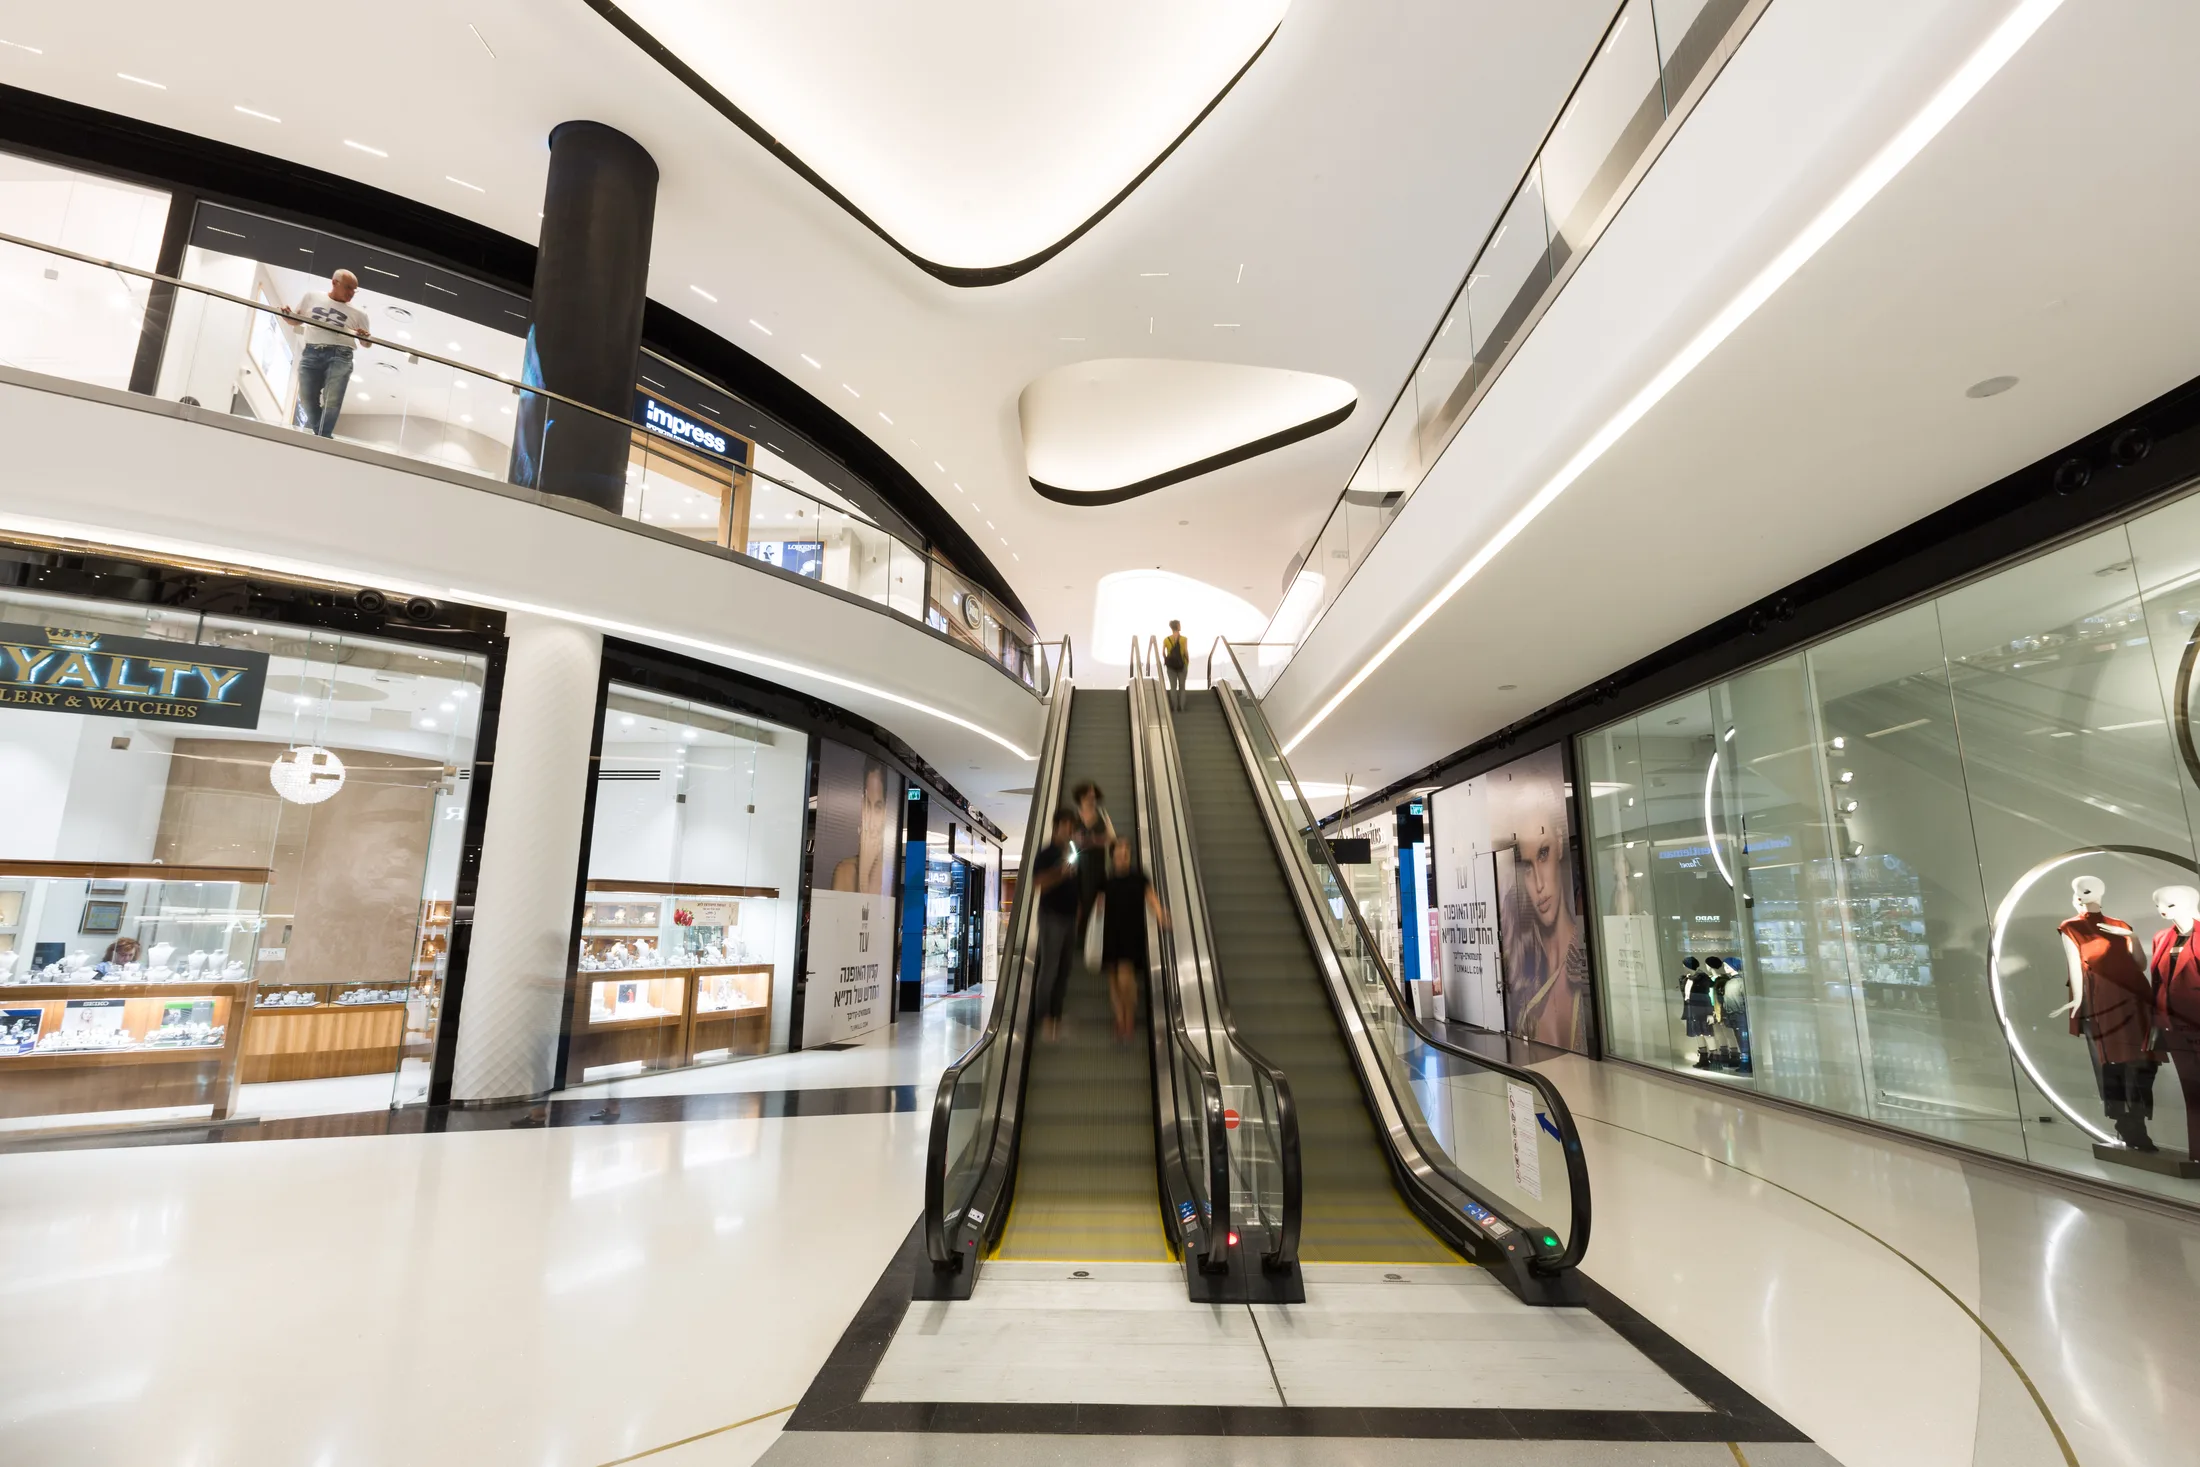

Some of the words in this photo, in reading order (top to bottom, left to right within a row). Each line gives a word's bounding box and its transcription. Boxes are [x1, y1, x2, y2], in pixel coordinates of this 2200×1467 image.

[646, 399, 726, 453] impress
[65, 695, 83, 709] &
[87, 696, 198, 718] WATCHES
[1444, 904, 1468, 920] האופנה
[1470, 902, 1486, 923] קניון
[1456, 924, 1468, 944] של
[1468, 927, 1494, 945] החדש
[840, 966, 866, 983] האופנה
